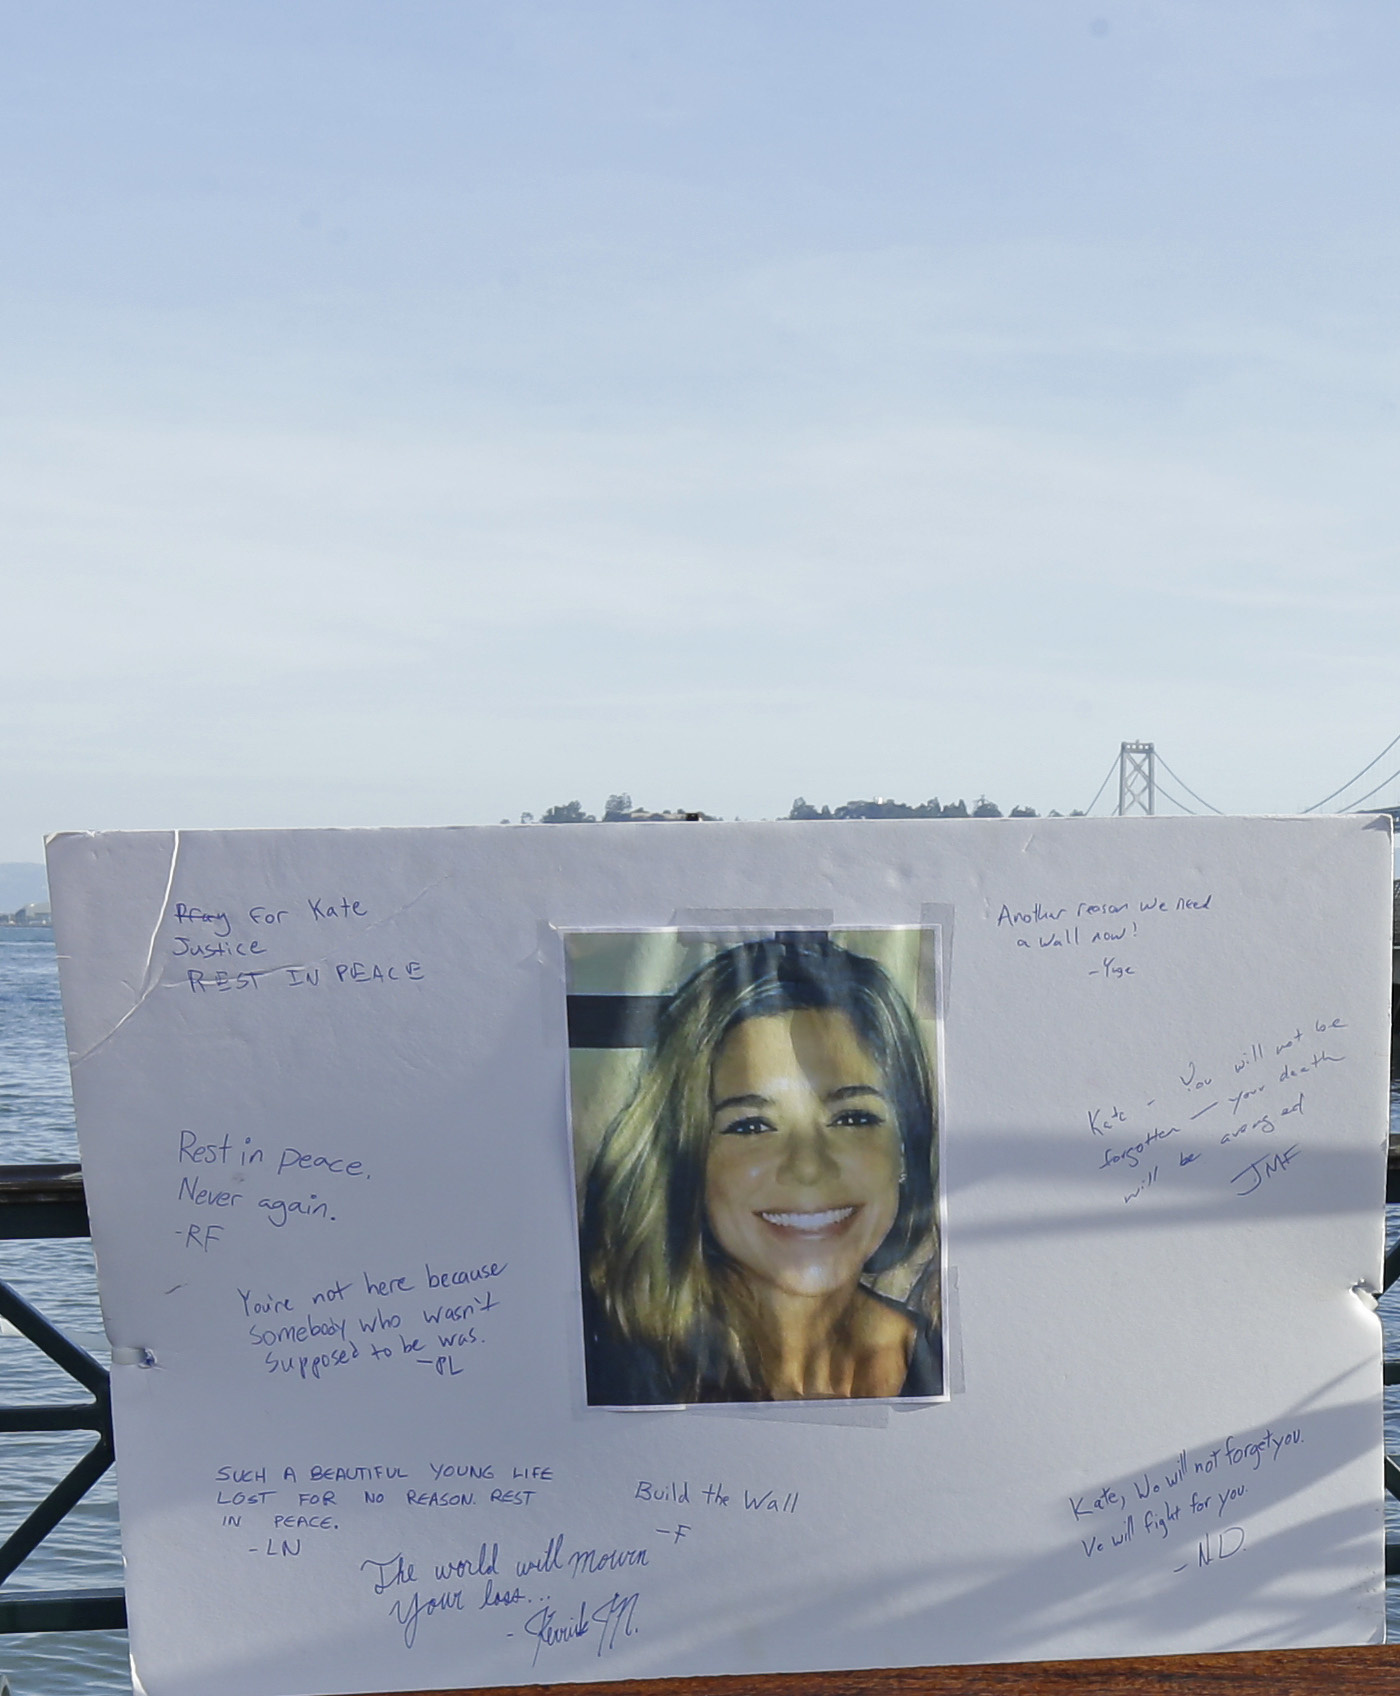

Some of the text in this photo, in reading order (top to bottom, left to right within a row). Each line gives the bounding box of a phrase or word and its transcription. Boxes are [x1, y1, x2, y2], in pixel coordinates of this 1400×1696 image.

[307, 897, 367, 920] Kate
[998, 903, 1066, 926] Another
[1076, 902, 1128, 917] reason
[1176, 894, 1212, 911] need
[172, 937, 266, 959] Justice
[1017, 938, 1030, 948] a
[1091, 921, 1138, 943] now!
[187, 961, 424, 993] REST IN PEACE
[1088, 1106, 1127, 1135] Kate
[1234, 1043, 1263, 1074] will
[1276, 1028, 1303, 1055] not
[1315, 1017, 1348, 1032] be
[1099, 1126, 1181, 1169] forgotten
[1228, 1085, 1265, 1115] your
[1279, 1051, 1346, 1083] death
[179, 1130, 232, 1164] Rest
[240, 1137, 264, 1166] in
[1124, 1166, 1159, 1204] will
[1179, 1151, 1202, 1167] be
[178, 1176, 337, 1228] Never again.
[174, 1223, 225, 1253] -RF
[237, 1262, 509, 1317] You're not here because
[359, 1308, 402, 1334] who
[422, 1290, 501, 1325] wasn't
[371, 1343, 393, 1360] to
[399, 1334, 426, 1352] be
[437, 1327, 486, 1349] was.
[215, 1463, 554, 1484] SUCH A BEAUTIFUL YOUNG LIFE
[1068, 1486, 1127, 1522] Kate,
[1165, 1449, 1188, 1489] will
[1193, 1450, 1221, 1475] not
[1224, 1429, 1272, 1471] forget
[1270, 1428, 1305, 1462] you.
[216, 1488, 537, 1507] LOST FOR NO REASON. REST
[634, 1480, 690, 1504] Build
[701, 1483, 730, 1507] the
[222, 1515, 339, 1530] IN PEACE.
[1111, 1514, 1134, 1547] will
[1143, 1501, 1182, 1540] fight
[1189, 1492, 1213, 1515] for
[1218, 1484, 1249, 1518] you.
[360, 1533, 651, 1595] The world will mourn
